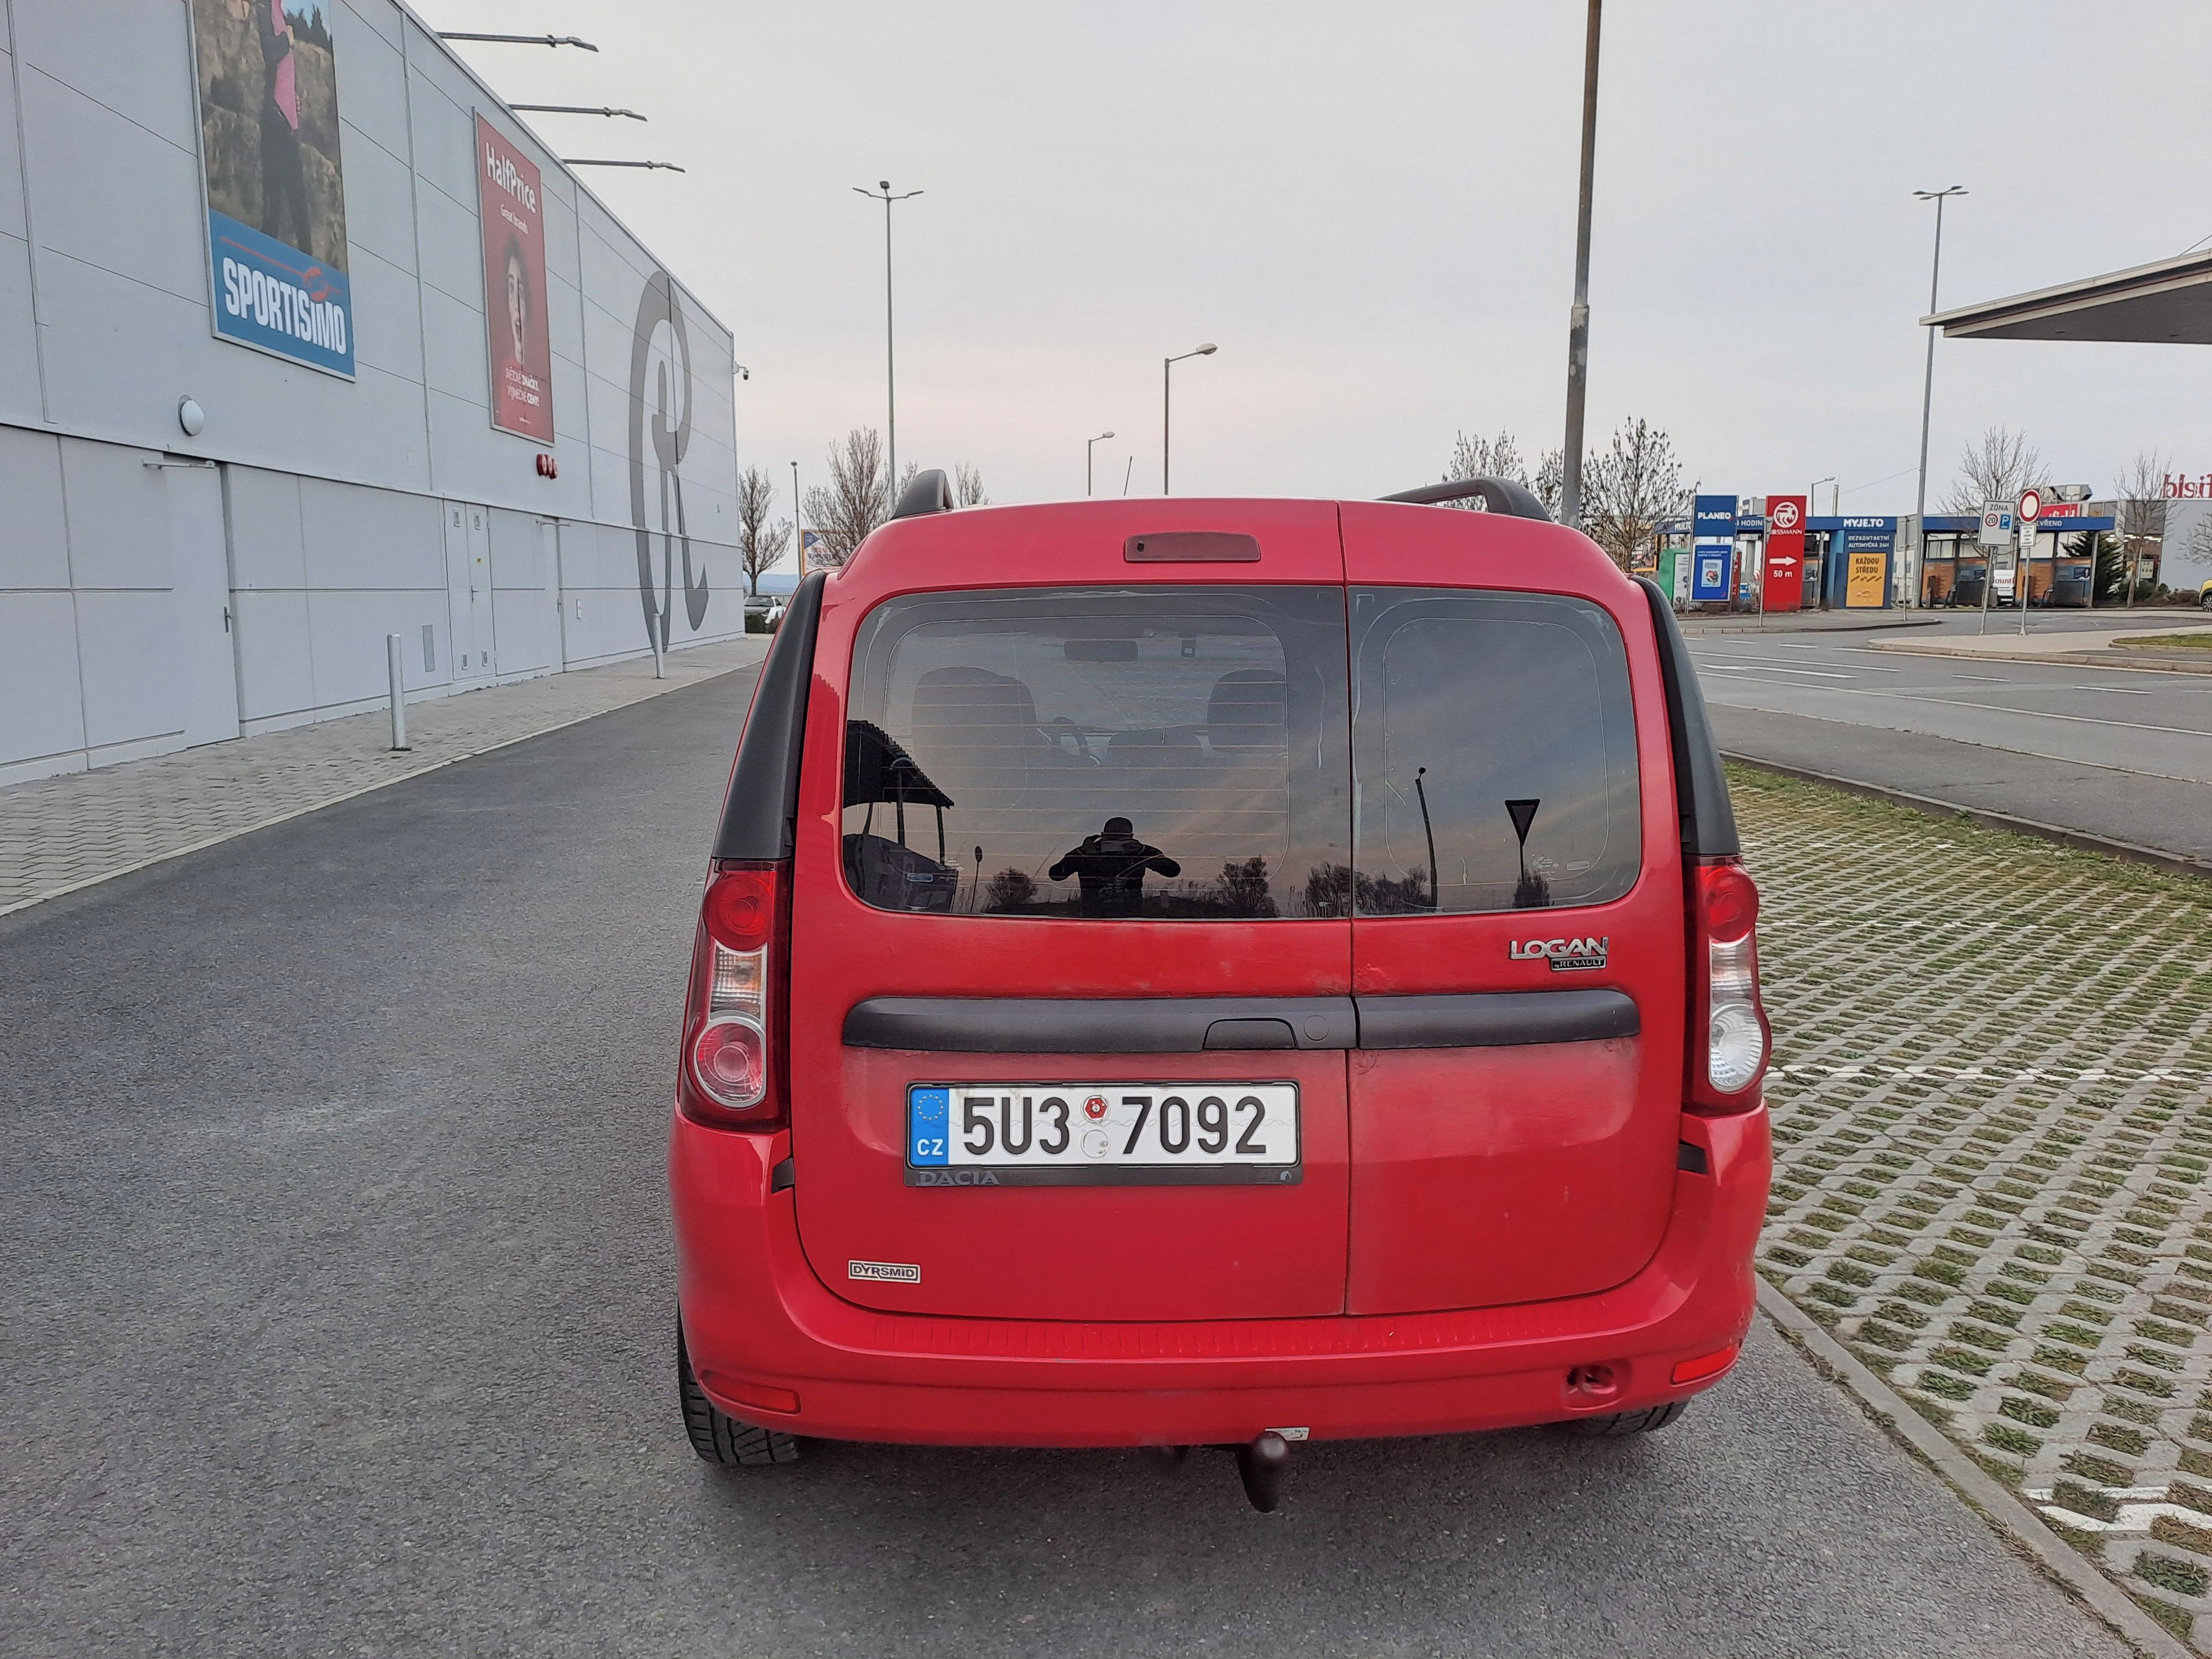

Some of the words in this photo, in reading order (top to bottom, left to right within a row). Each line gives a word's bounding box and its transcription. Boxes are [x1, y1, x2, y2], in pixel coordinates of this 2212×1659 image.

[486, 141, 536, 213] HalfPrice
[223, 257, 347, 354] SPORTISIMO
[1698, 512, 1731, 520] PLANEO
[1843, 518, 1884, 528] MYJE.TO
[1510, 937, 1608, 959] LOGAN
[1560, 959, 1603, 967] RENAULT
[963, 1096, 1070, 1155] 5U3
[1121, 1095, 1267, 1155] 7092
[917, 1139, 943, 1156] CZ
[919, 1171, 1000, 1185] DACIA
[852, 1264, 916, 1279] DYRSMID
